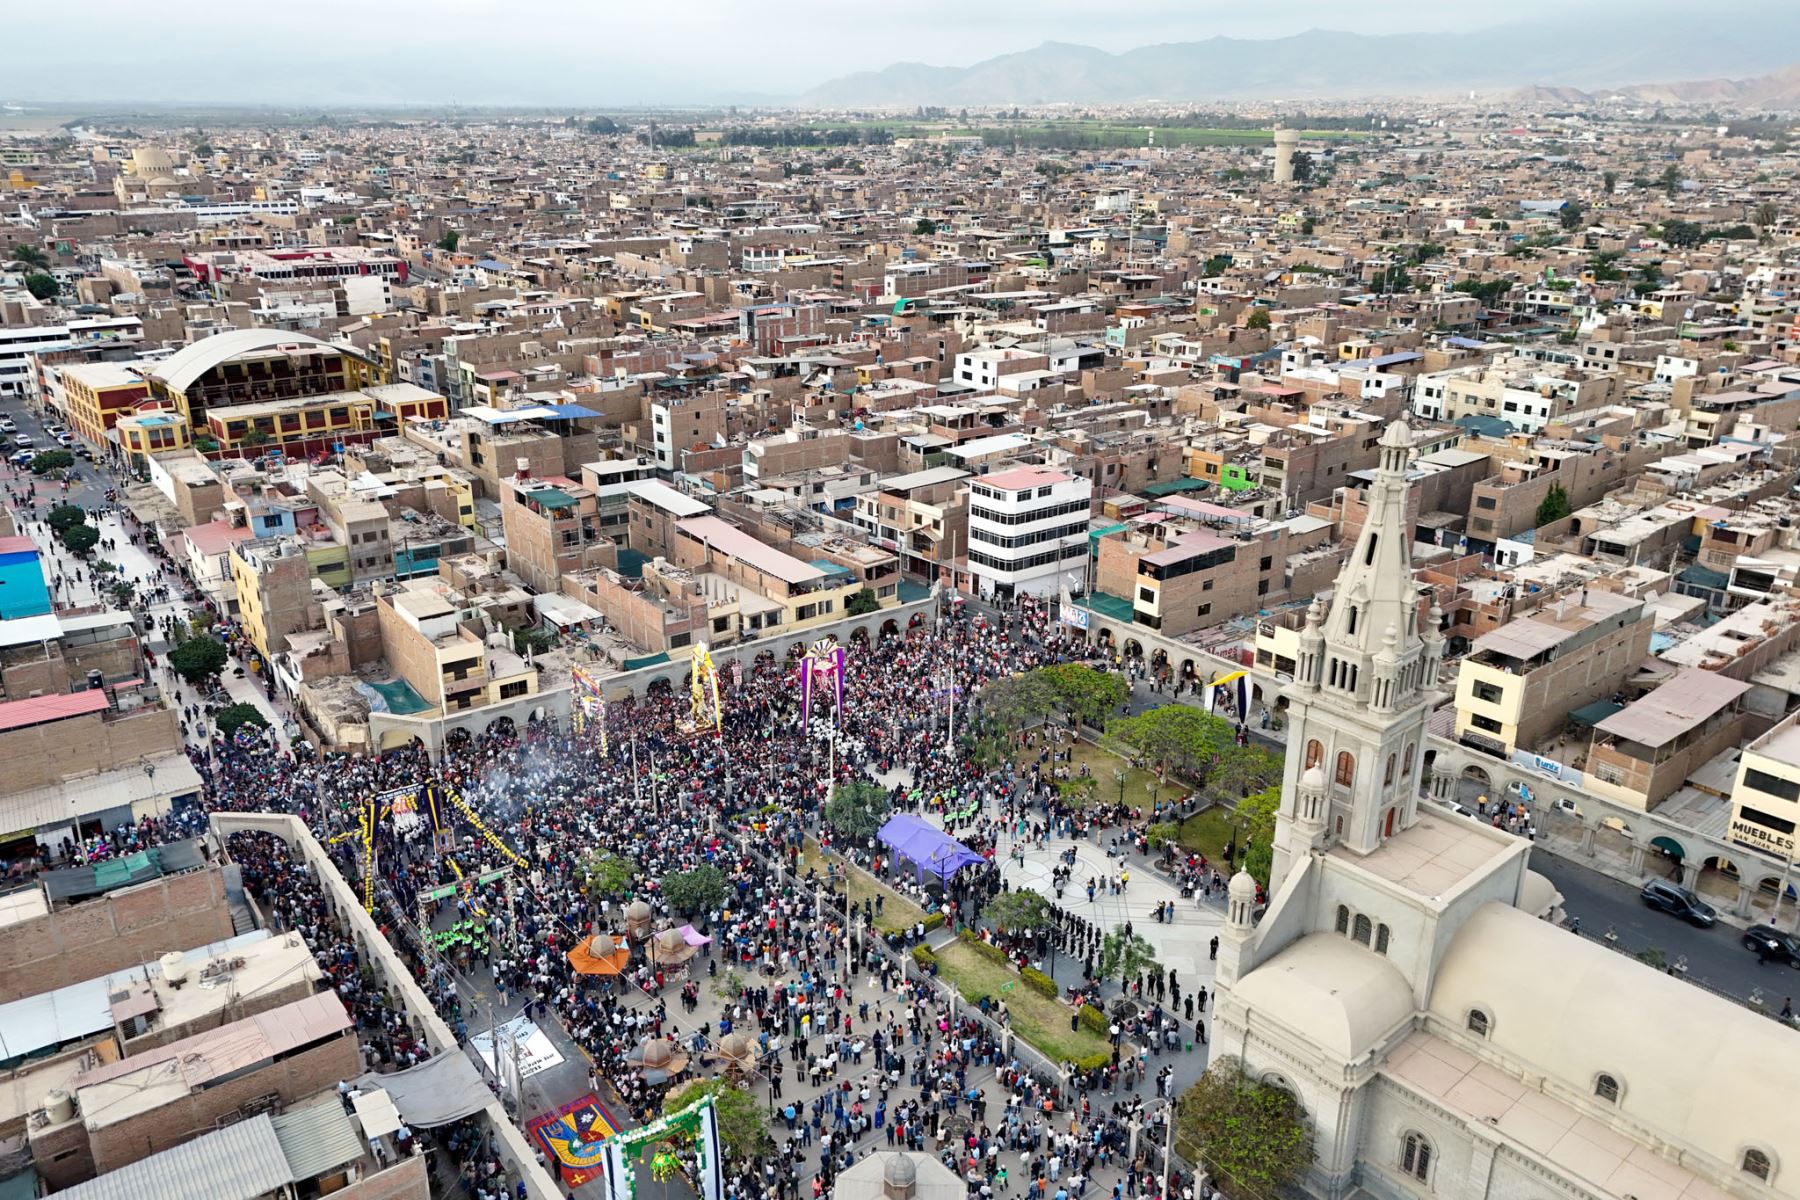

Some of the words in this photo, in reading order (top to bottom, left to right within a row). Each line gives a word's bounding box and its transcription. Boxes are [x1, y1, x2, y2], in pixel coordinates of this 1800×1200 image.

[1732, 821, 1794, 850] MUEBLES
[1734, 832, 1748, 842] SAN
[1751, 839, 1771, 850] JUAN
